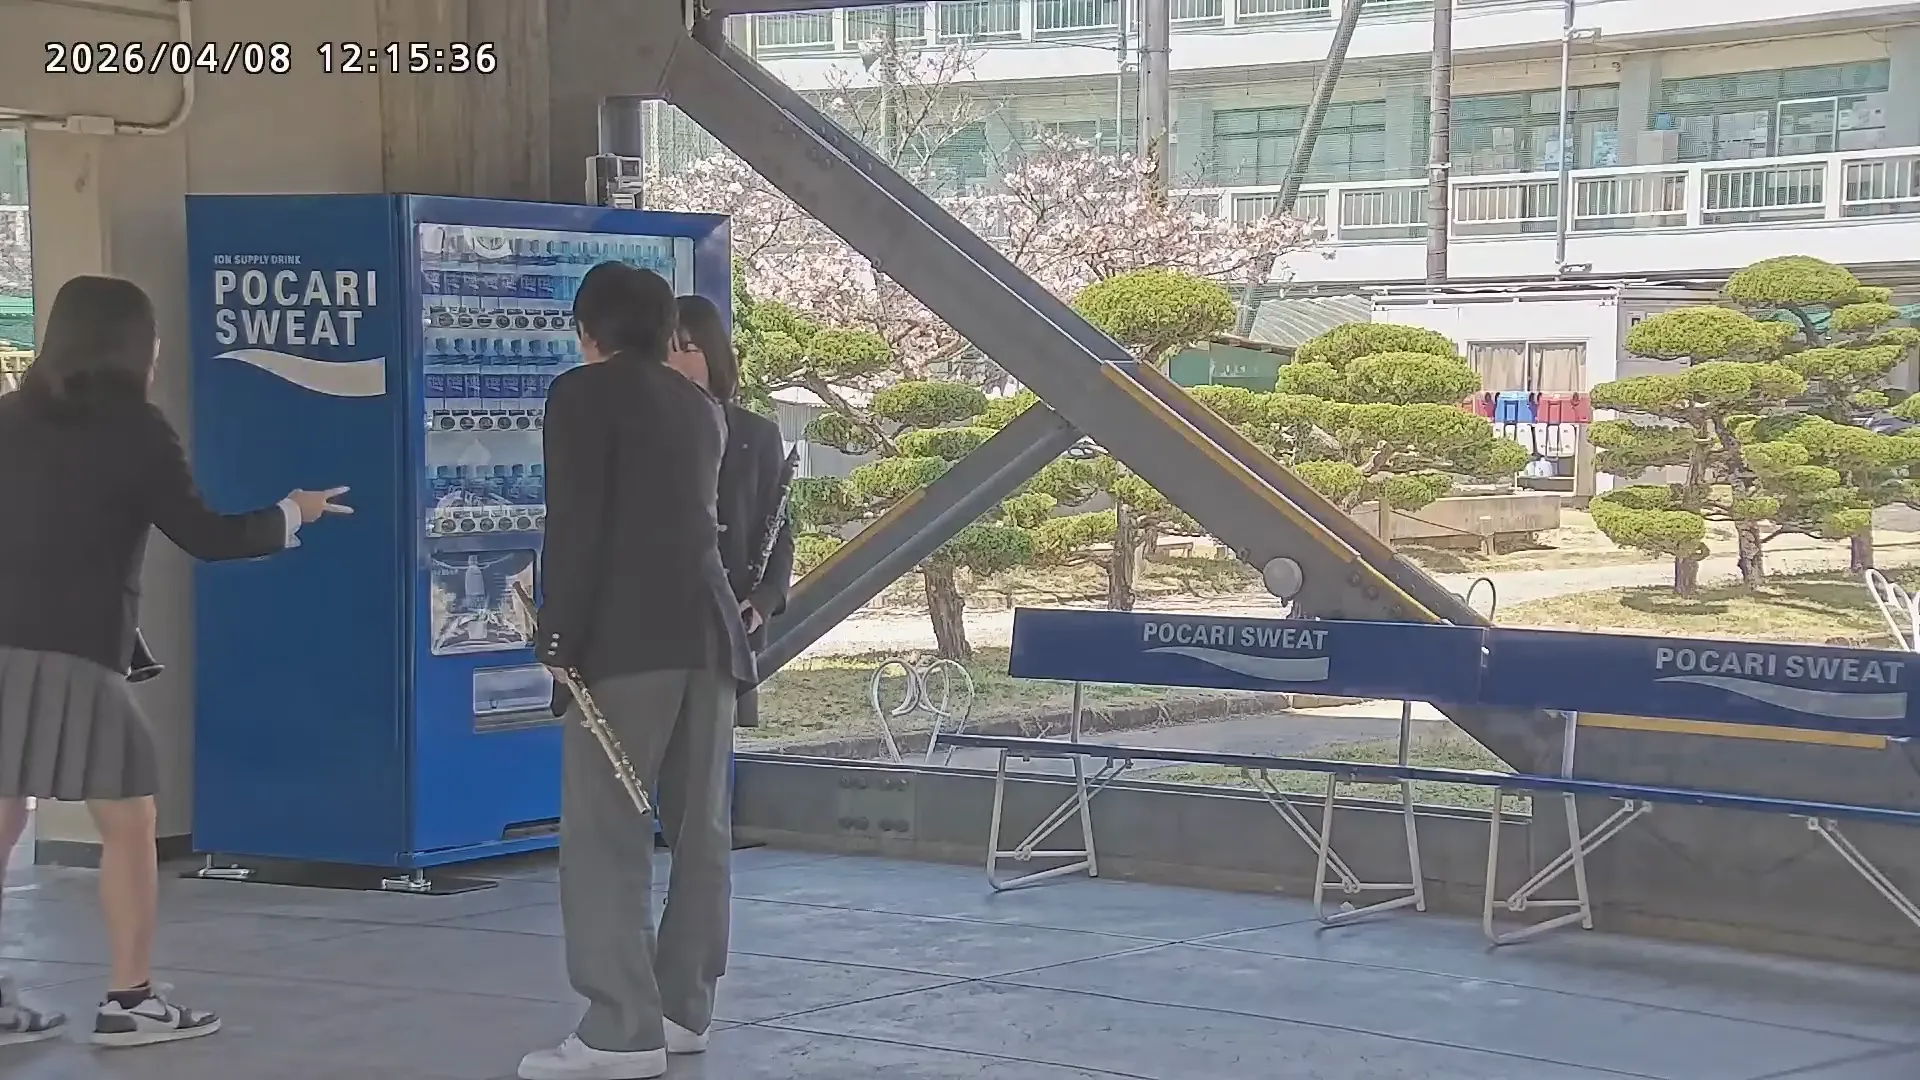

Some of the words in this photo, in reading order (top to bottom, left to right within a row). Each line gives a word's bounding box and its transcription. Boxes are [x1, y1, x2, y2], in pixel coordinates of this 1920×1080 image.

[214, 255, 232, 264] ION
[234, 255, 269, 264] SUPPLY
[271, 255, 301, 265] DRINK
[215, 270, 377, 306] POCARI
[215, 308, 363, 345] SWEAT
[1143, 622, 1235, 645] POCARI
[1240, 626, 1329, 650] SWEAT
[1655, 647, 1776, 676] POCARI
[1785, 654, 1905, 684] SWEAT
